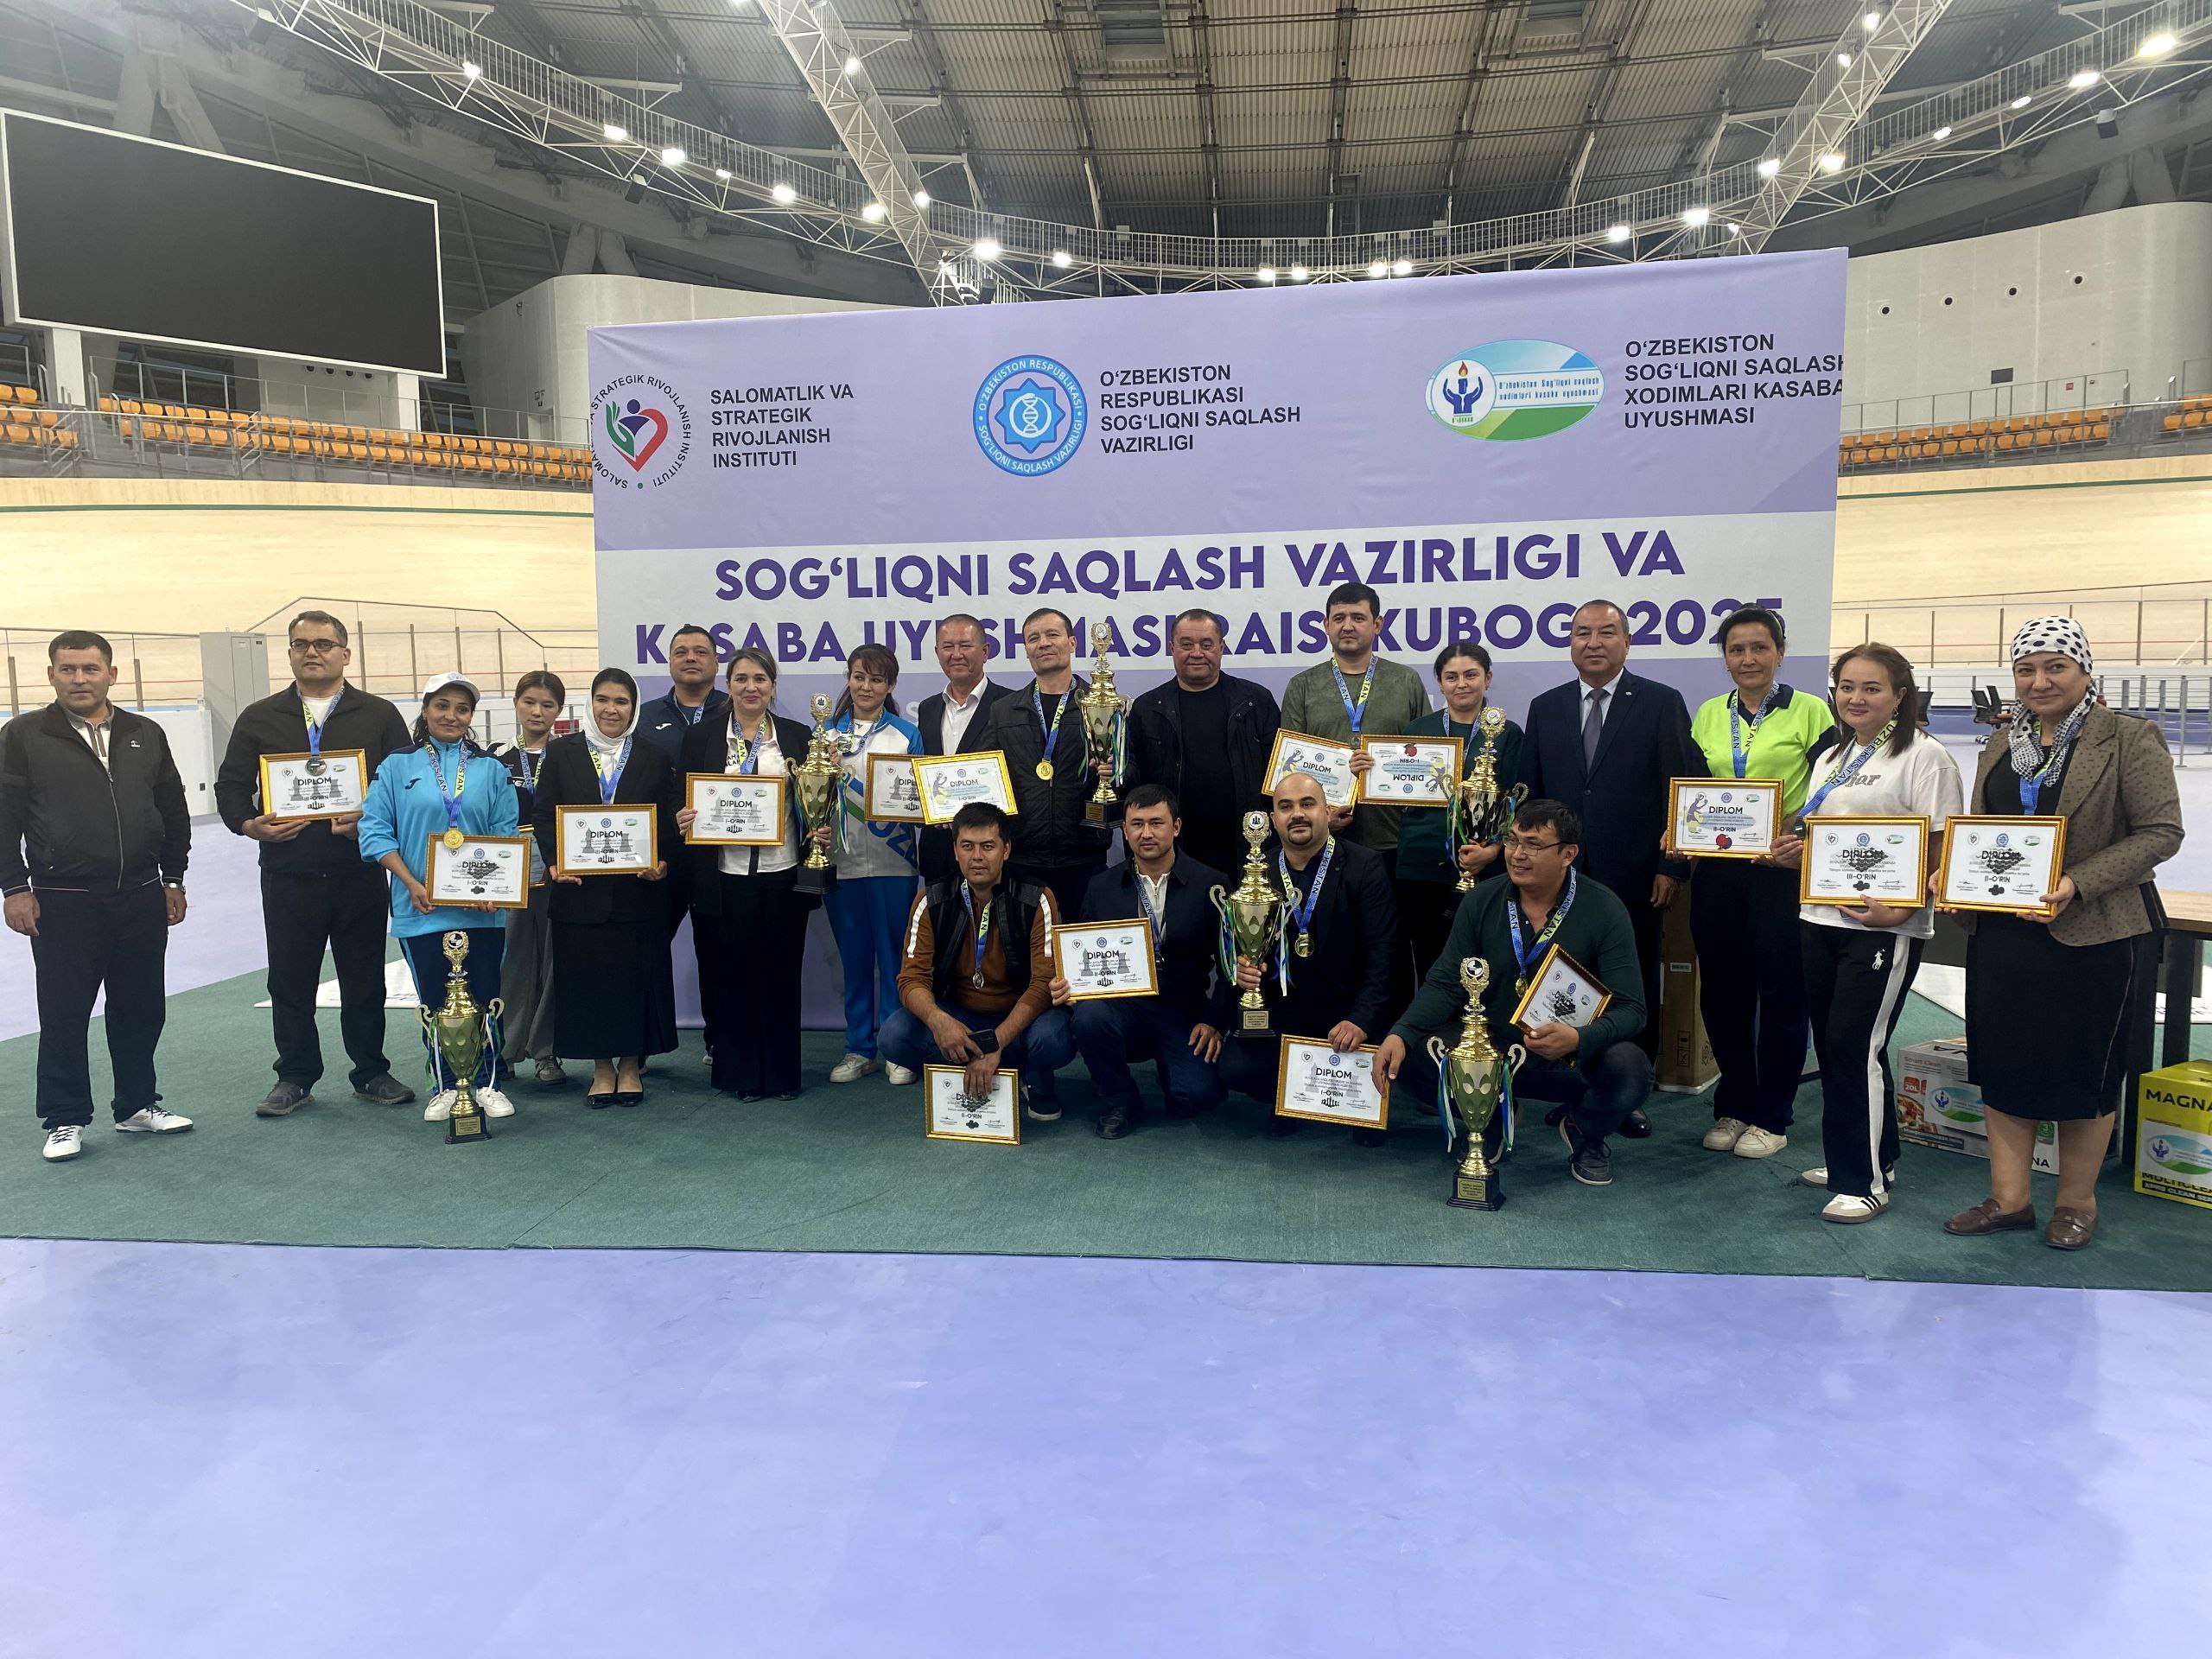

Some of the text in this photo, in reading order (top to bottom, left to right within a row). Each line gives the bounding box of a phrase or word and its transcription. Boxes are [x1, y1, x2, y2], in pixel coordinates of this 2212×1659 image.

[1626, 334, 1774, 358] O‘ZBEKISTON
[1100, 364, 1231, 387] O‘ZBEKISTON
[1625, 359, 1737, 382] SOG‘LIQNI
[591, 374, 645, 410] STRATEGIK
[710, 384, 855, 404] SALOMATLIK VA
[1028, 359, 1083, 409] RESPUBLIKASI
[1624, 383, 1746, 405] XODIMLARI
[646, 376, 692, 439] RIVOJLANISH
[1101, 386, 1243, 409] RESPUBLIKASI
[711, 407, 813, 426] STRATEGIK
[1101, 406, 1300, 432] SOG‘LIQNI SAQLASH
[1624, 408, 1754, 429] UYUSHMASI
[712, 429, 831, 447] RIVOJLANISH
[1011, 460, 1055, 473] SAQLASH
[1052, 419, 1083, 462] VAZIRLIGI
[1101, 434, 1193, 454] VAZIRLIGI
[652, 442, 690, 487] INSTITUTI
[713, 450, 797, 468] INSTITUTI
[715, 530, 1686, 603] SOG‘LIQNI SAQLASH VAZIRLIGI VA
[636, 620, 847, 664] KSABA
[1831, 723, 1897, 786] UZBEKISTAN
[426, 746, 448, 791] BEKISTAN
[456, 746, 467, 791] BEKISTAN
[1302, 761, 1332, 774] DIPLOM
[1393, 773, 1424, 782] DIPLOM
[297, 777, 332, 786] DIPLOM
[950, 779, 979, 787] DIPLOM
[1312, 837, 1335, 894] ZBEKISTAN
[1087, 950, 1120, 960] DIPLOM
[1316, 1067, 1352, 1079] DIPLOM
